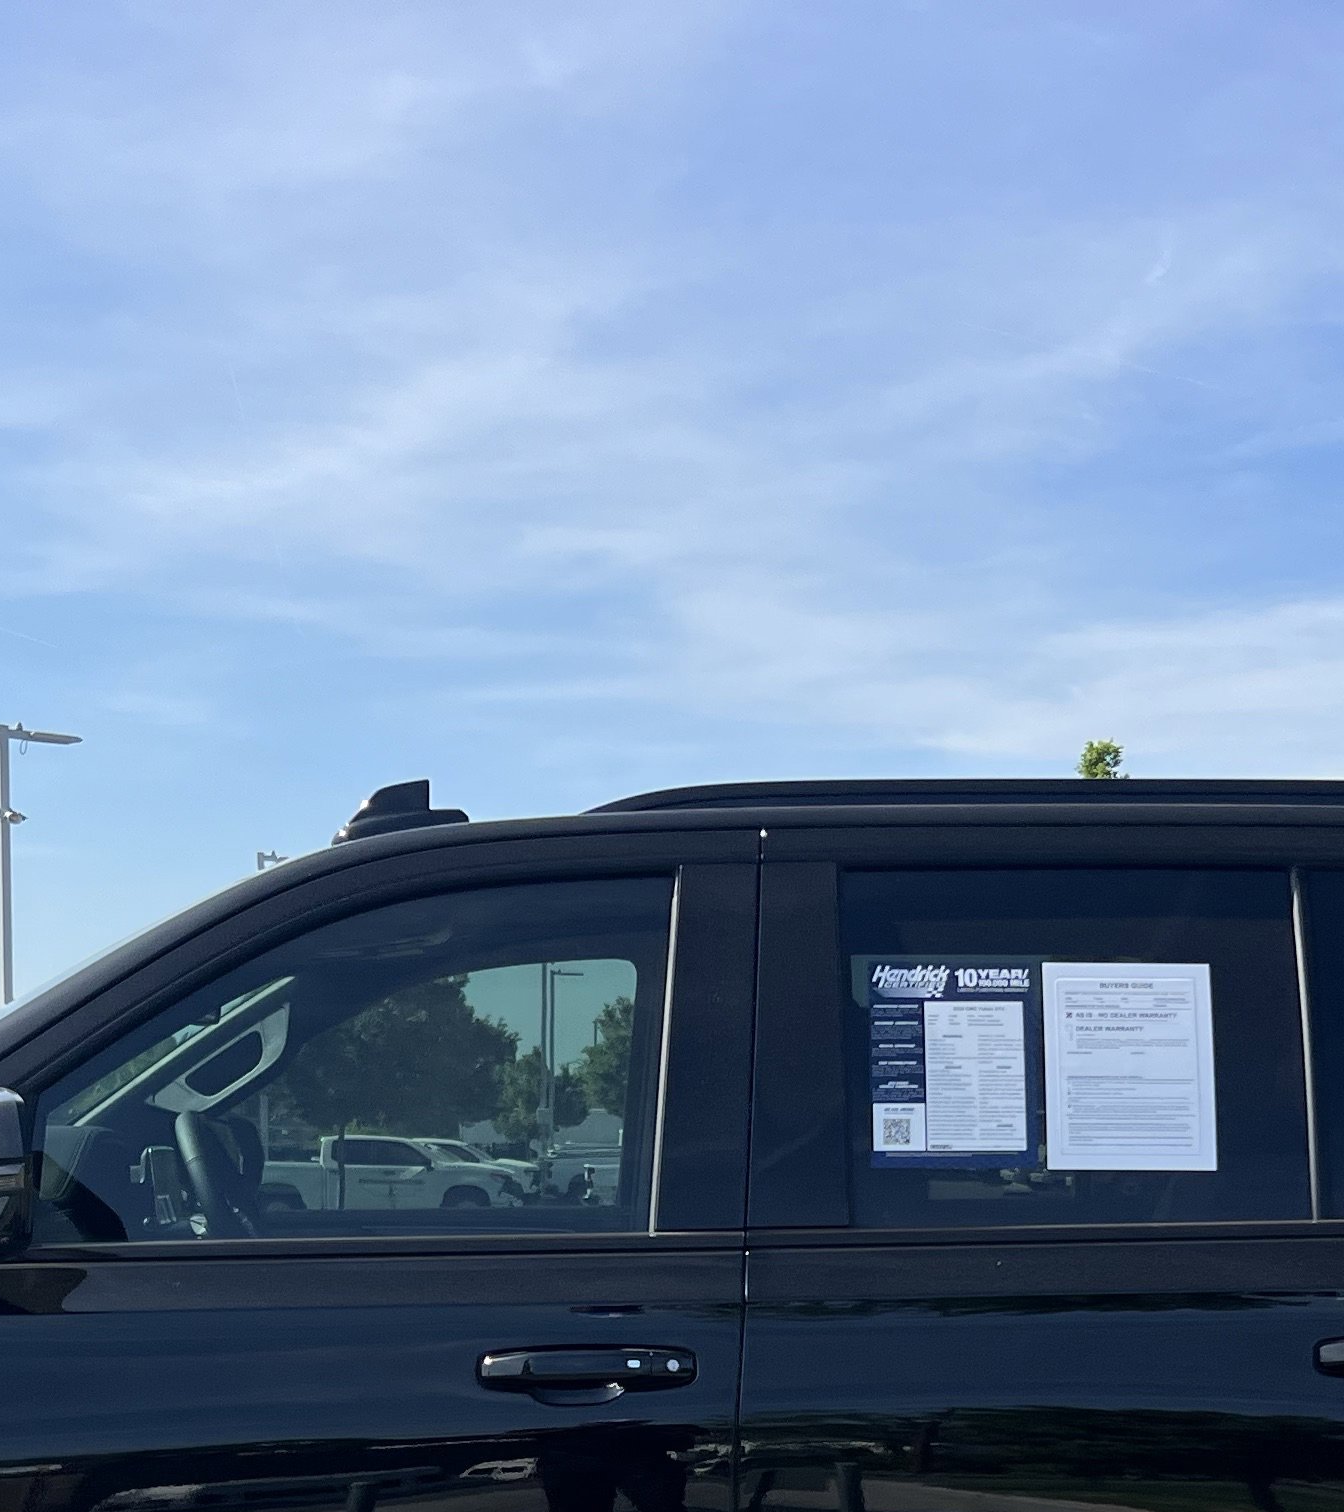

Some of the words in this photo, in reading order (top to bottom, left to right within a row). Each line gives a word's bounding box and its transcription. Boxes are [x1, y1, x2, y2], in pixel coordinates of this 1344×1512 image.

[871, 965, 950, 988] Hendrick
[954, 968, 978, 987] 10
[1010, 979, 1030, 987] MILE
